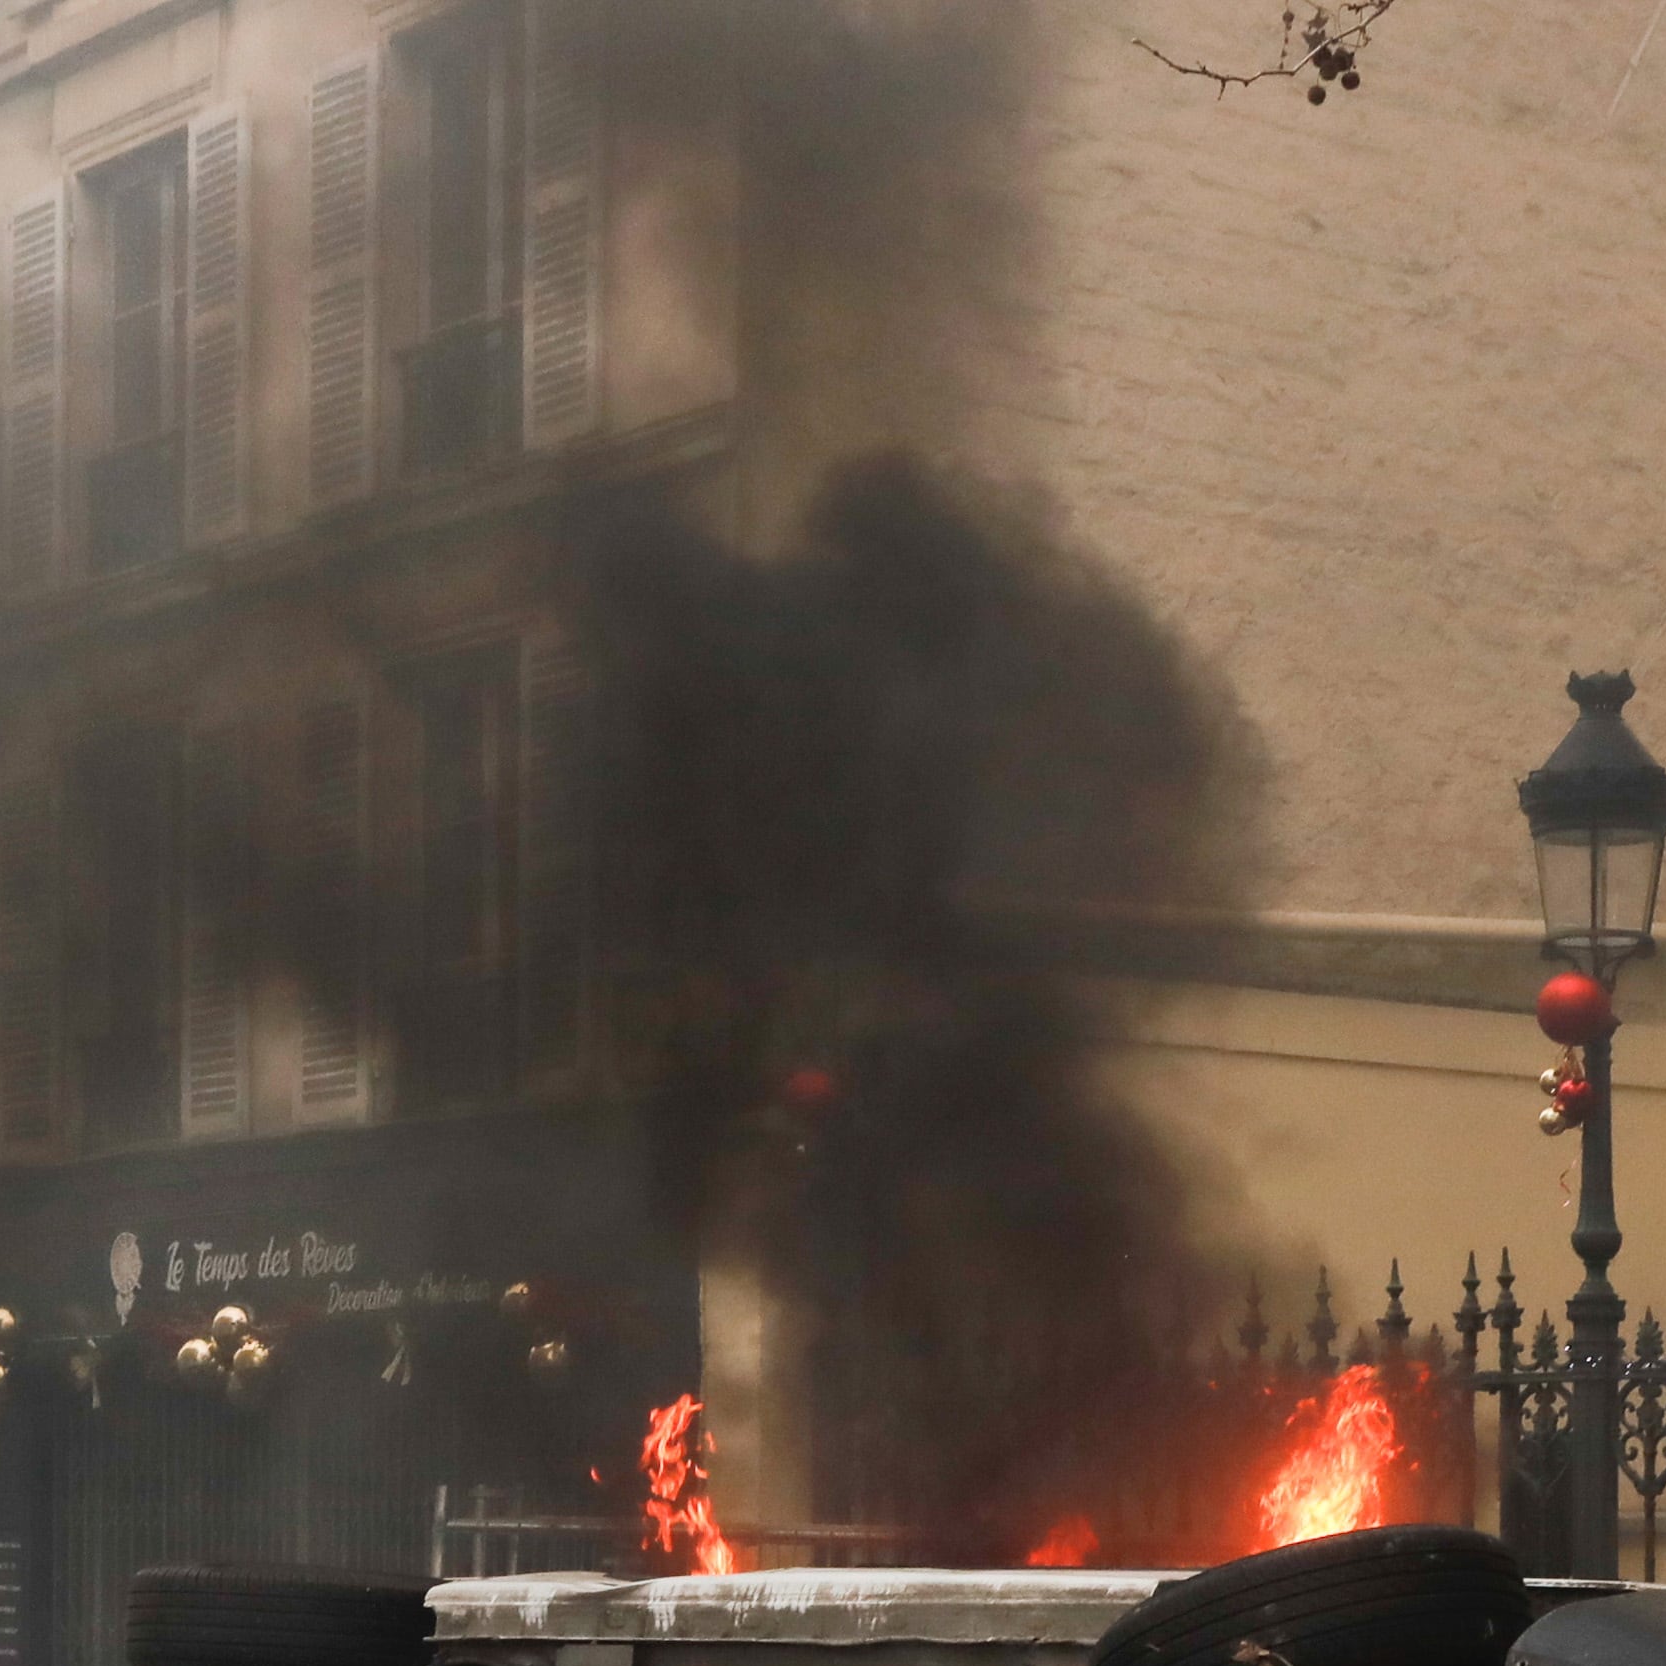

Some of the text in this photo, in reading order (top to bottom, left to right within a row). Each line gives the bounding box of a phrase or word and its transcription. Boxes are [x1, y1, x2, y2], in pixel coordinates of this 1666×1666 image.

[165, 1231, 357, 1291] Le Temps des Rêves
